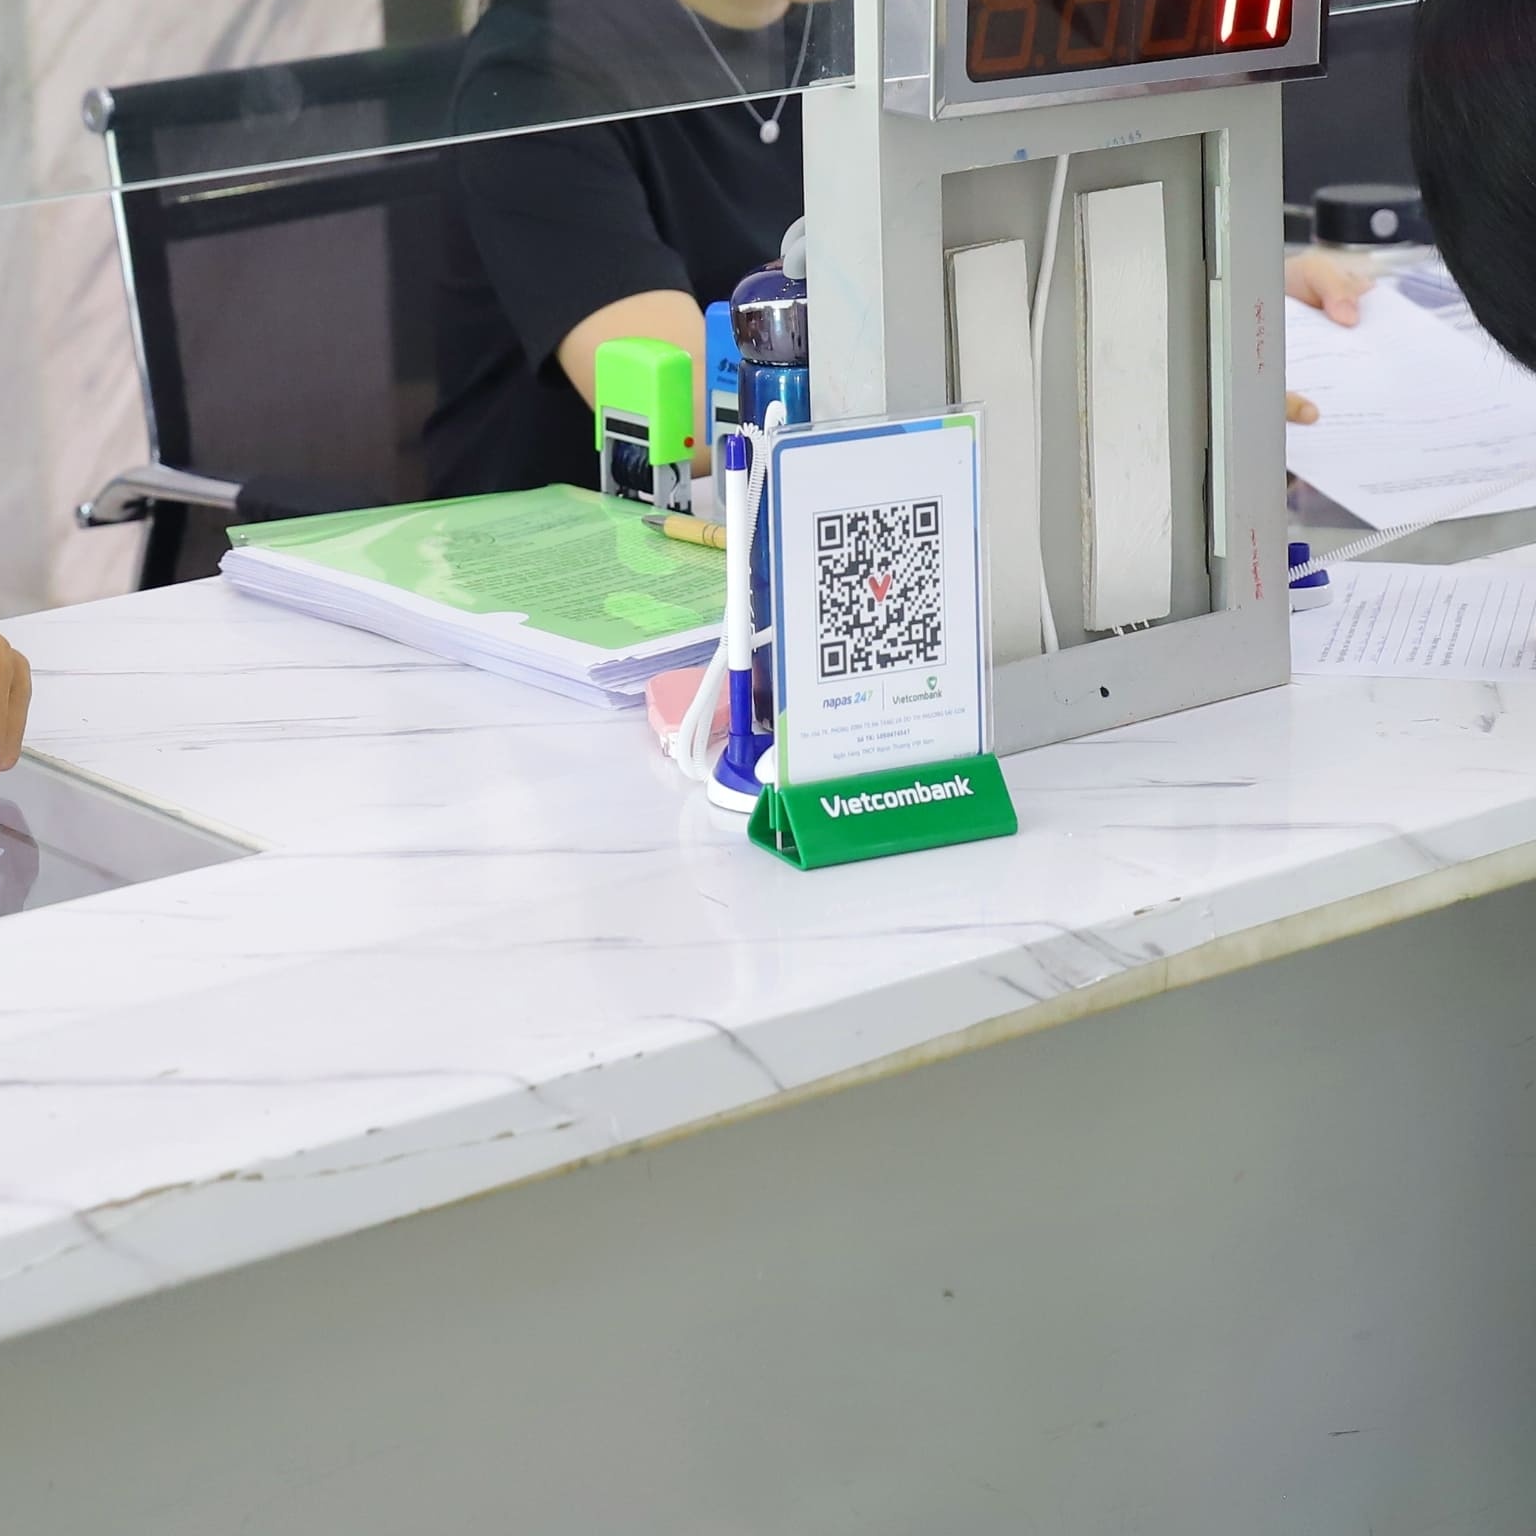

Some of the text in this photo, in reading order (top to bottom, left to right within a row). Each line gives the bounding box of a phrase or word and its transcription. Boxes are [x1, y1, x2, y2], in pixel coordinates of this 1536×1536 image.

[822, 690, 874, 709] napas 247
[892, 688, 943, 705] Vietcombank
[820, 774, 974, 818] Vietcombank
